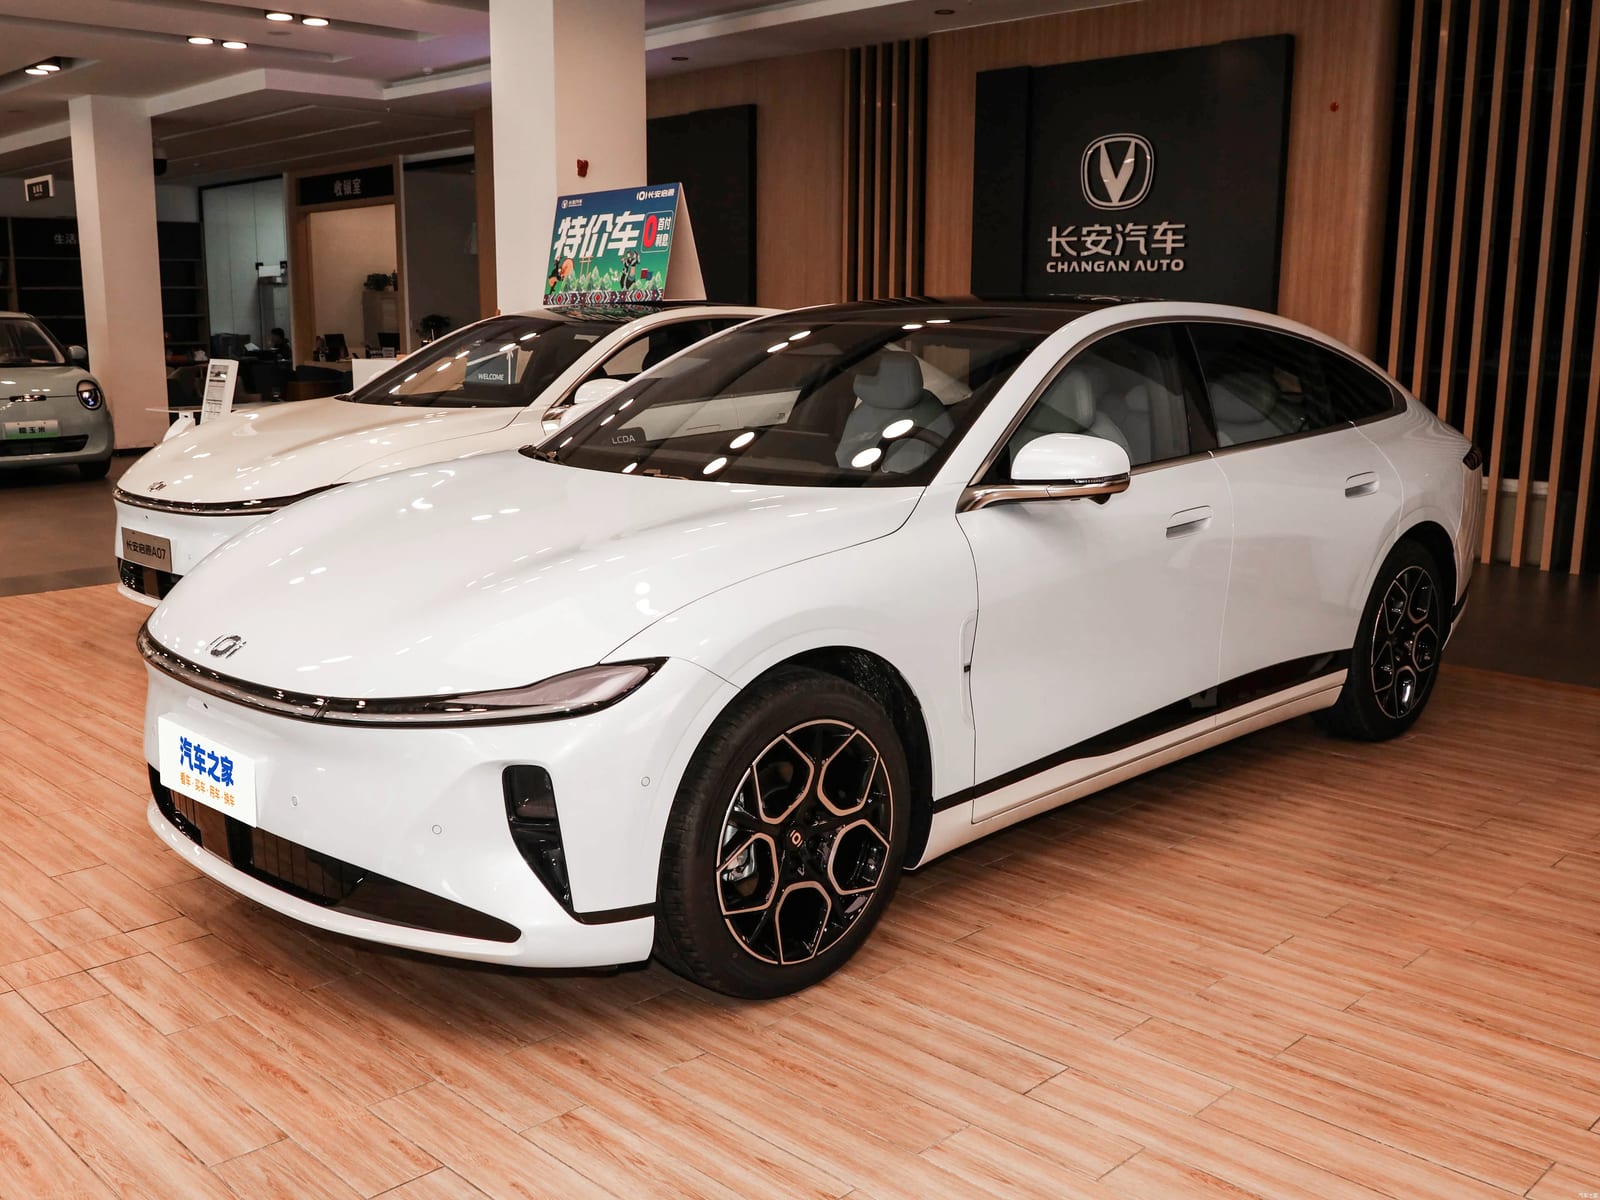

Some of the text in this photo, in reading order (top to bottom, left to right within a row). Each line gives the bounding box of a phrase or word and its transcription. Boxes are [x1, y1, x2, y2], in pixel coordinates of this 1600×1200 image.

[554, 211, 645, 259] 特价车
[644, 215, 658, 248] 0
[657, 216, 672, 231] 首付
[1047, 221, 1186, 258] 长安汽车
[1046, 259, 1185, 273] CHANGAN AUTO
[478, 373, 504, 381] WELCOME
[179, 735, 234, 787] 汽车之家
